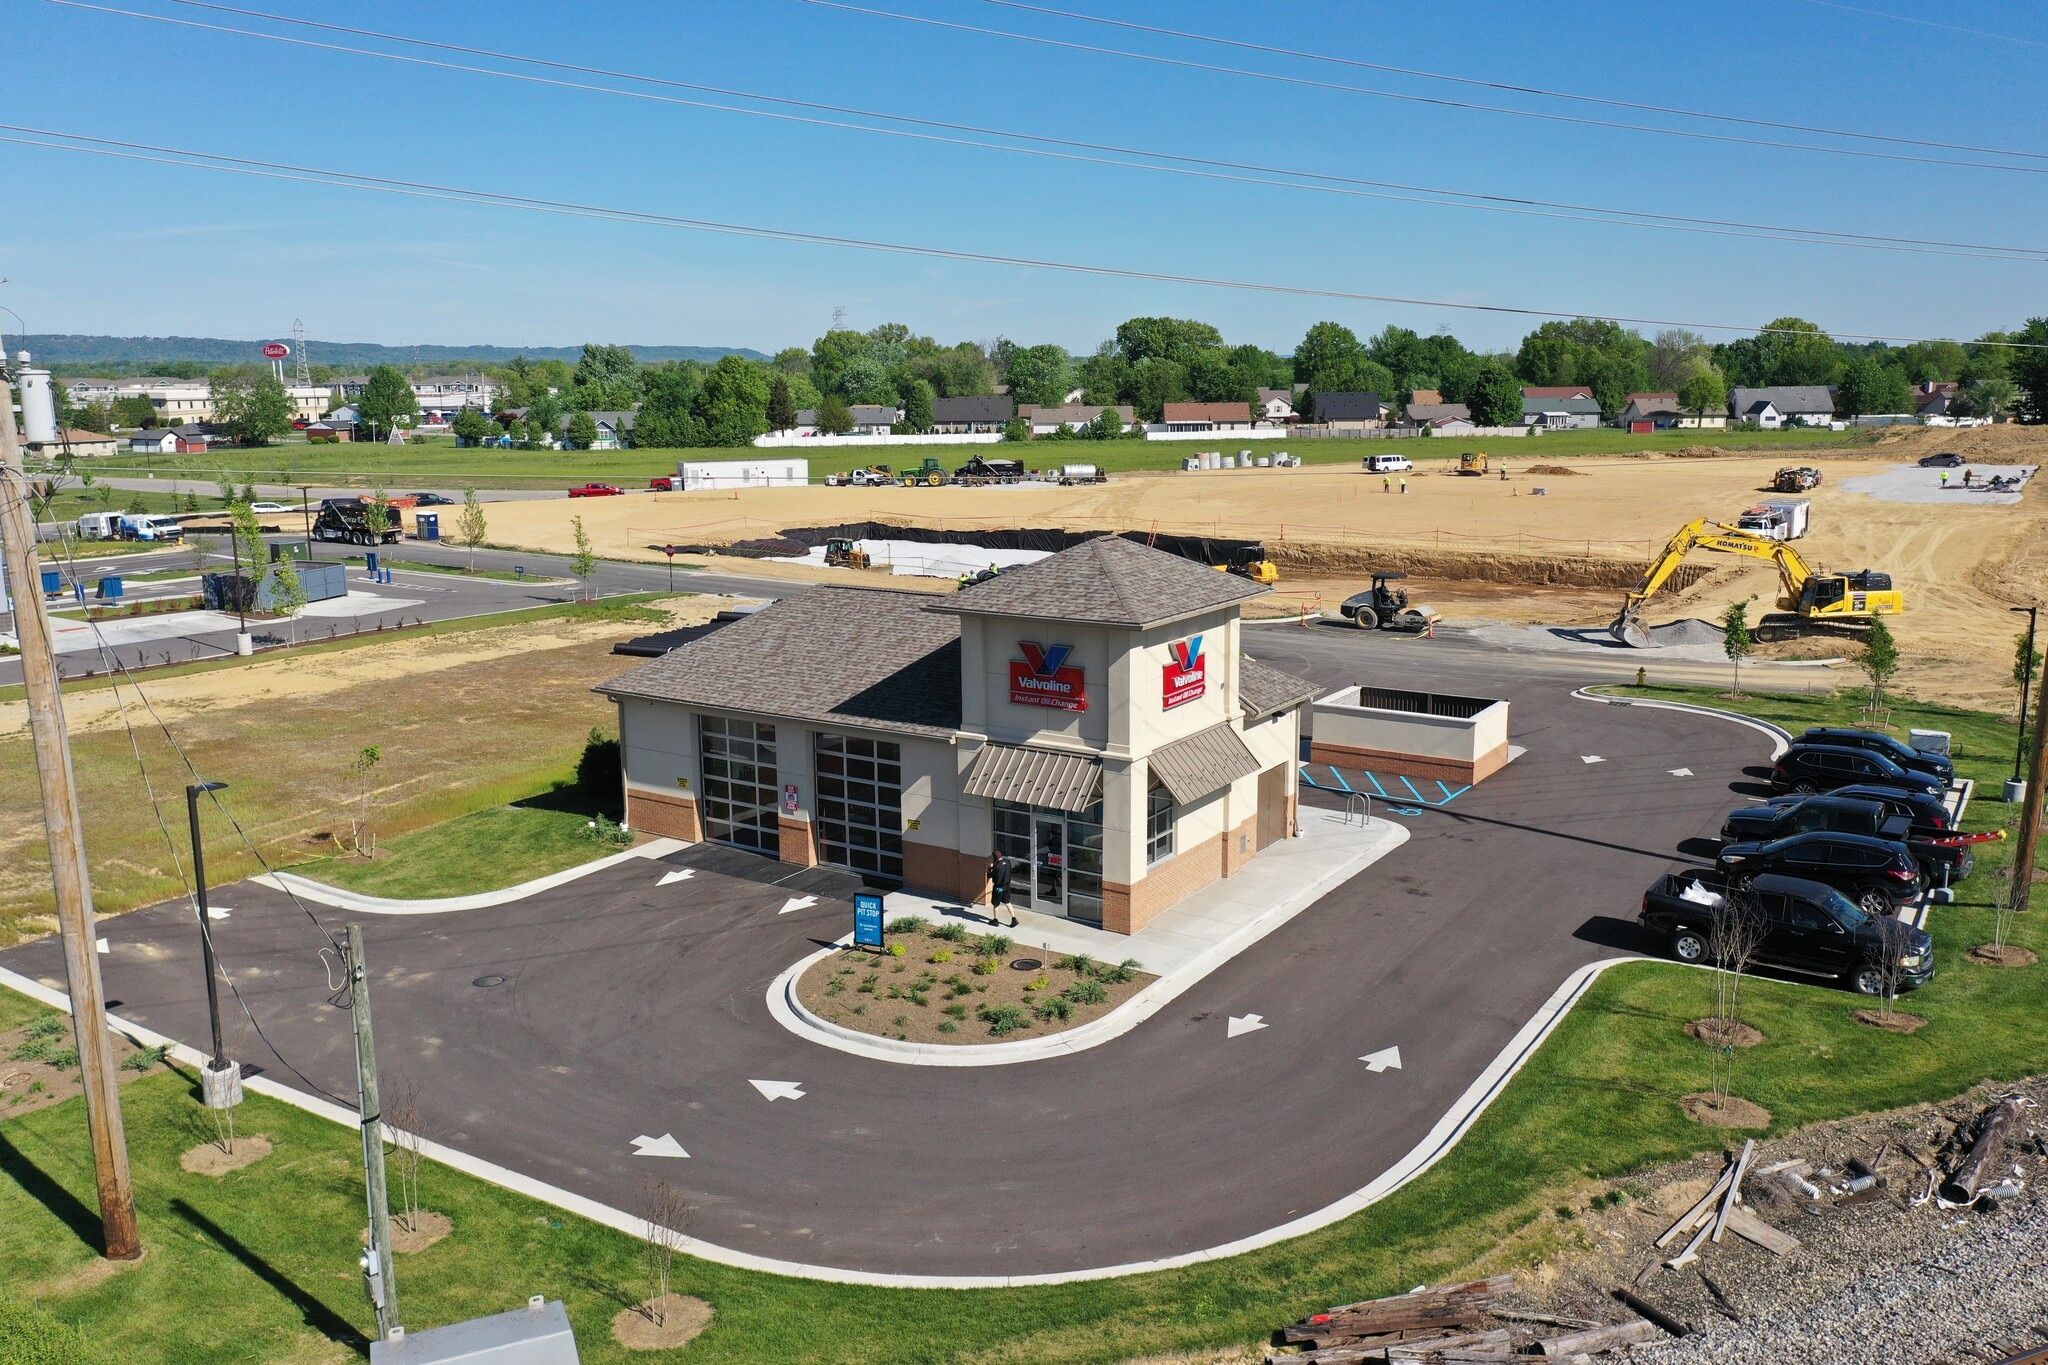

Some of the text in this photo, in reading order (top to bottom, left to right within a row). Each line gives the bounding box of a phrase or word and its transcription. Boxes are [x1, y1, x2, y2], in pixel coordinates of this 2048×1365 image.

[1716, 540, 1753, 551] KOMATSU
[1018, 676, 1071, 693] Valvoline
[1173, 671, 1203, 688] Valvoline
[1014, 694, 1078, 709] Instant Oil Change
[860, 901, 877, 910] QUICK
[857, 908, 880, 918] PIT STOP
